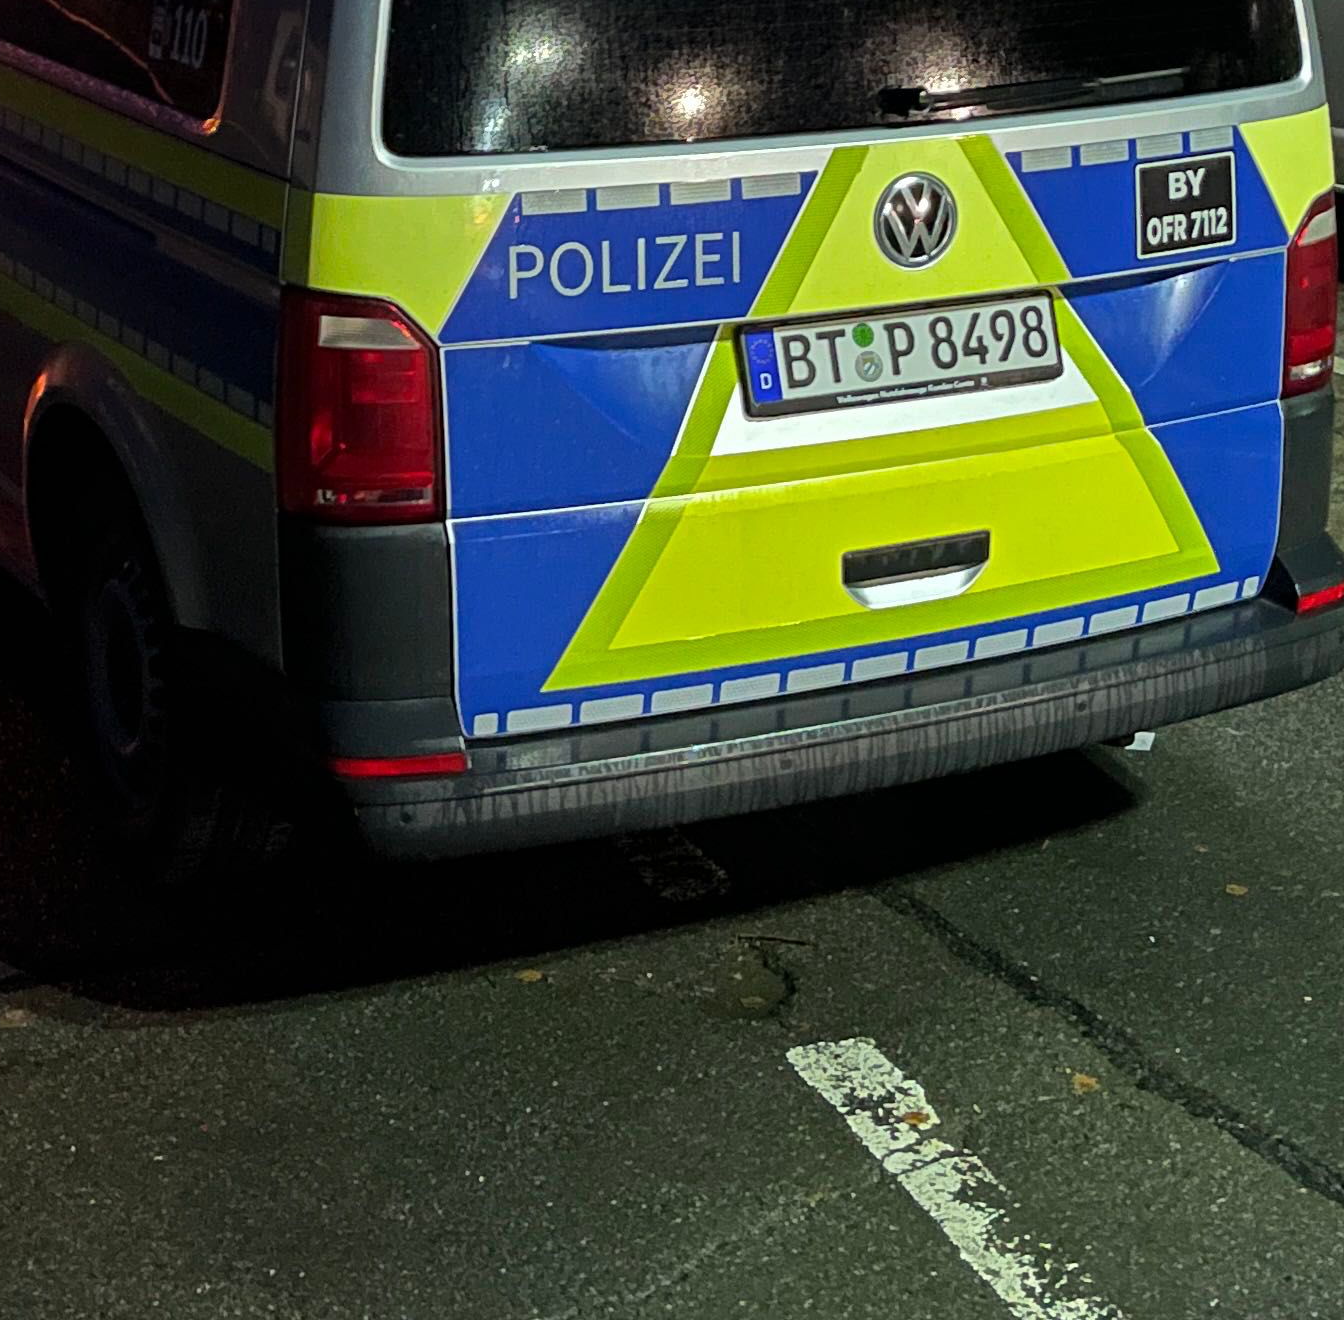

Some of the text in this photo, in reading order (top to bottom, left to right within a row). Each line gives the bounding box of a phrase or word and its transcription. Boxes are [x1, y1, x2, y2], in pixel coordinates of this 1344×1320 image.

[1167, 166, 1206, 200] BY
[1145, 205, 1228, 247] OFR 7112
[508, 230, 741, 300] POLIZEI
[779, 304, 1049, 390] BT P 8498
[759, 372, 773, 390] D
